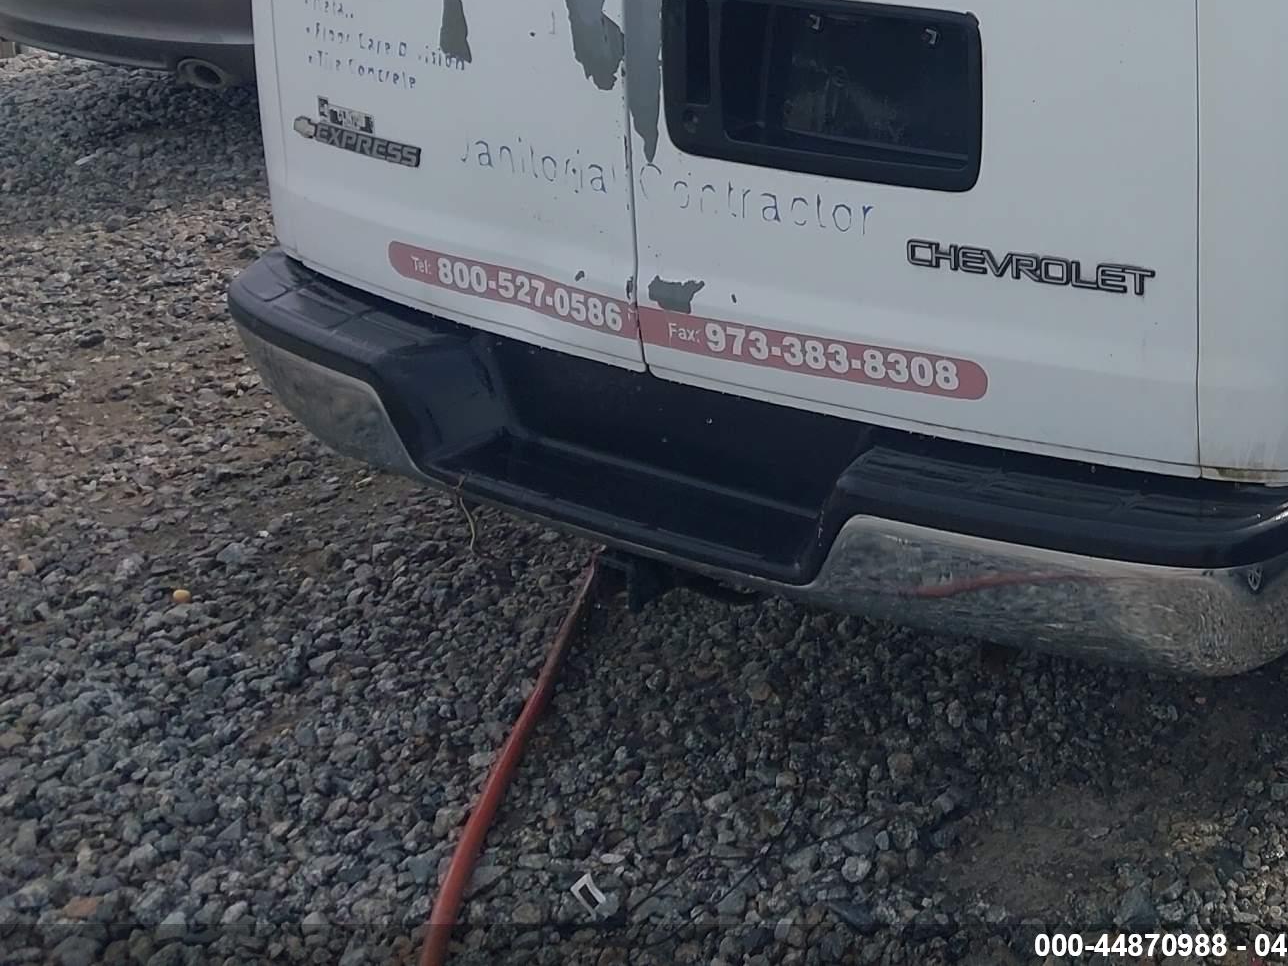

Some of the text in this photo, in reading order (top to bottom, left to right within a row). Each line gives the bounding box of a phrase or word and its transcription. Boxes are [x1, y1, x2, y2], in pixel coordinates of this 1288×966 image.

[314, 122, 421, 168] EXPRESS
[411, 255, 624, 333] Tel: 800-527-0586
[906, 238, 1156, 296] CHEVROLET
[668, 320, 960, 391] Fax: 973-383-8308
